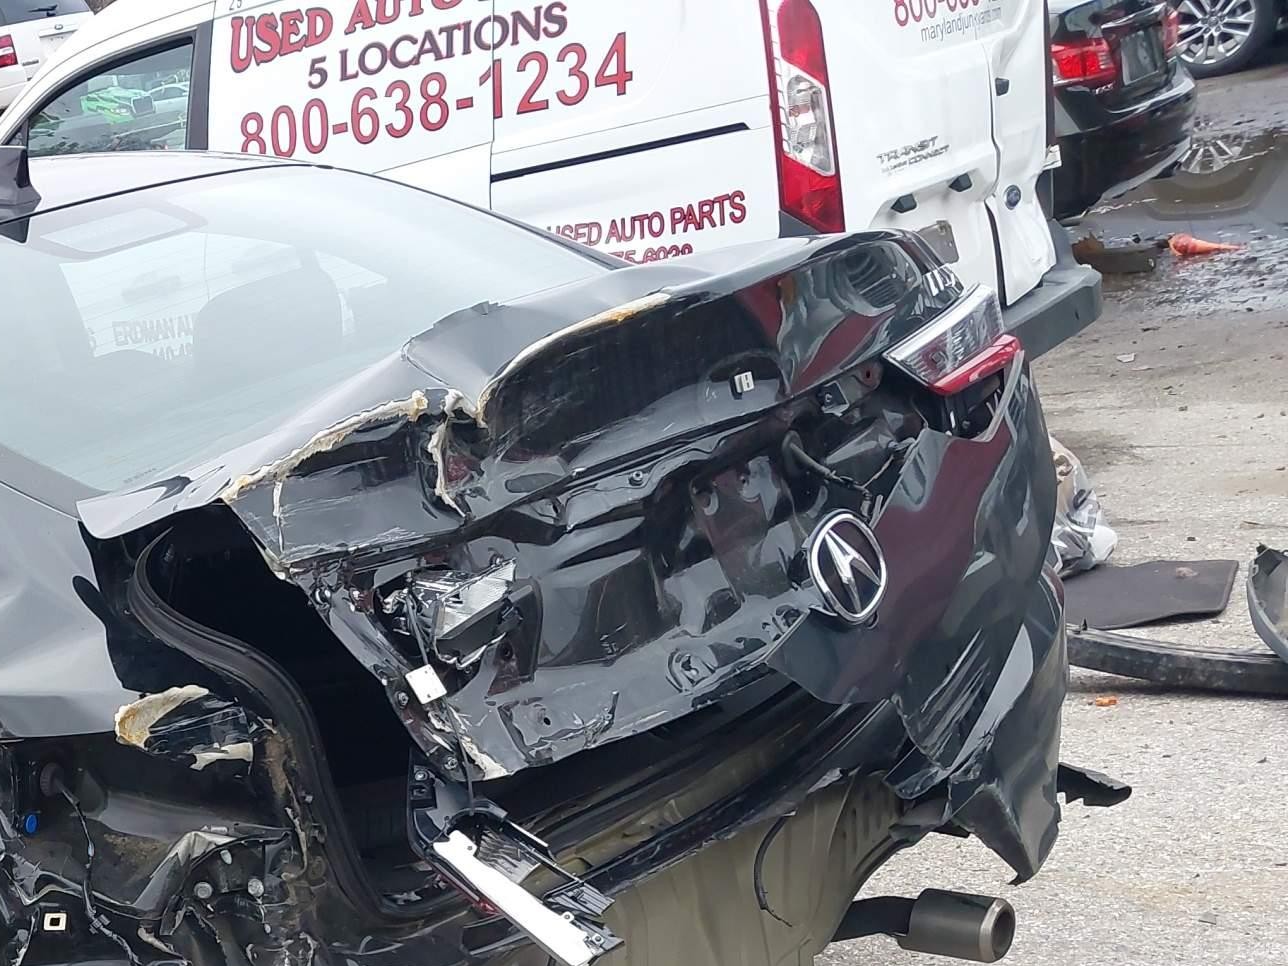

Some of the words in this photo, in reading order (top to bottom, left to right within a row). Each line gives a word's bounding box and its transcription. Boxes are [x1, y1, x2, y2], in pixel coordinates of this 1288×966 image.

[231, 7, 334, 74] USED
[308, 56, 328, 89] 5
[339, 2, 568, 82] LOCATIONS
[240, 32, 633, 158] 800-638-1234
[605, 211, 665, 245] AUTO
[670, 190, 747, 235] PARTS
